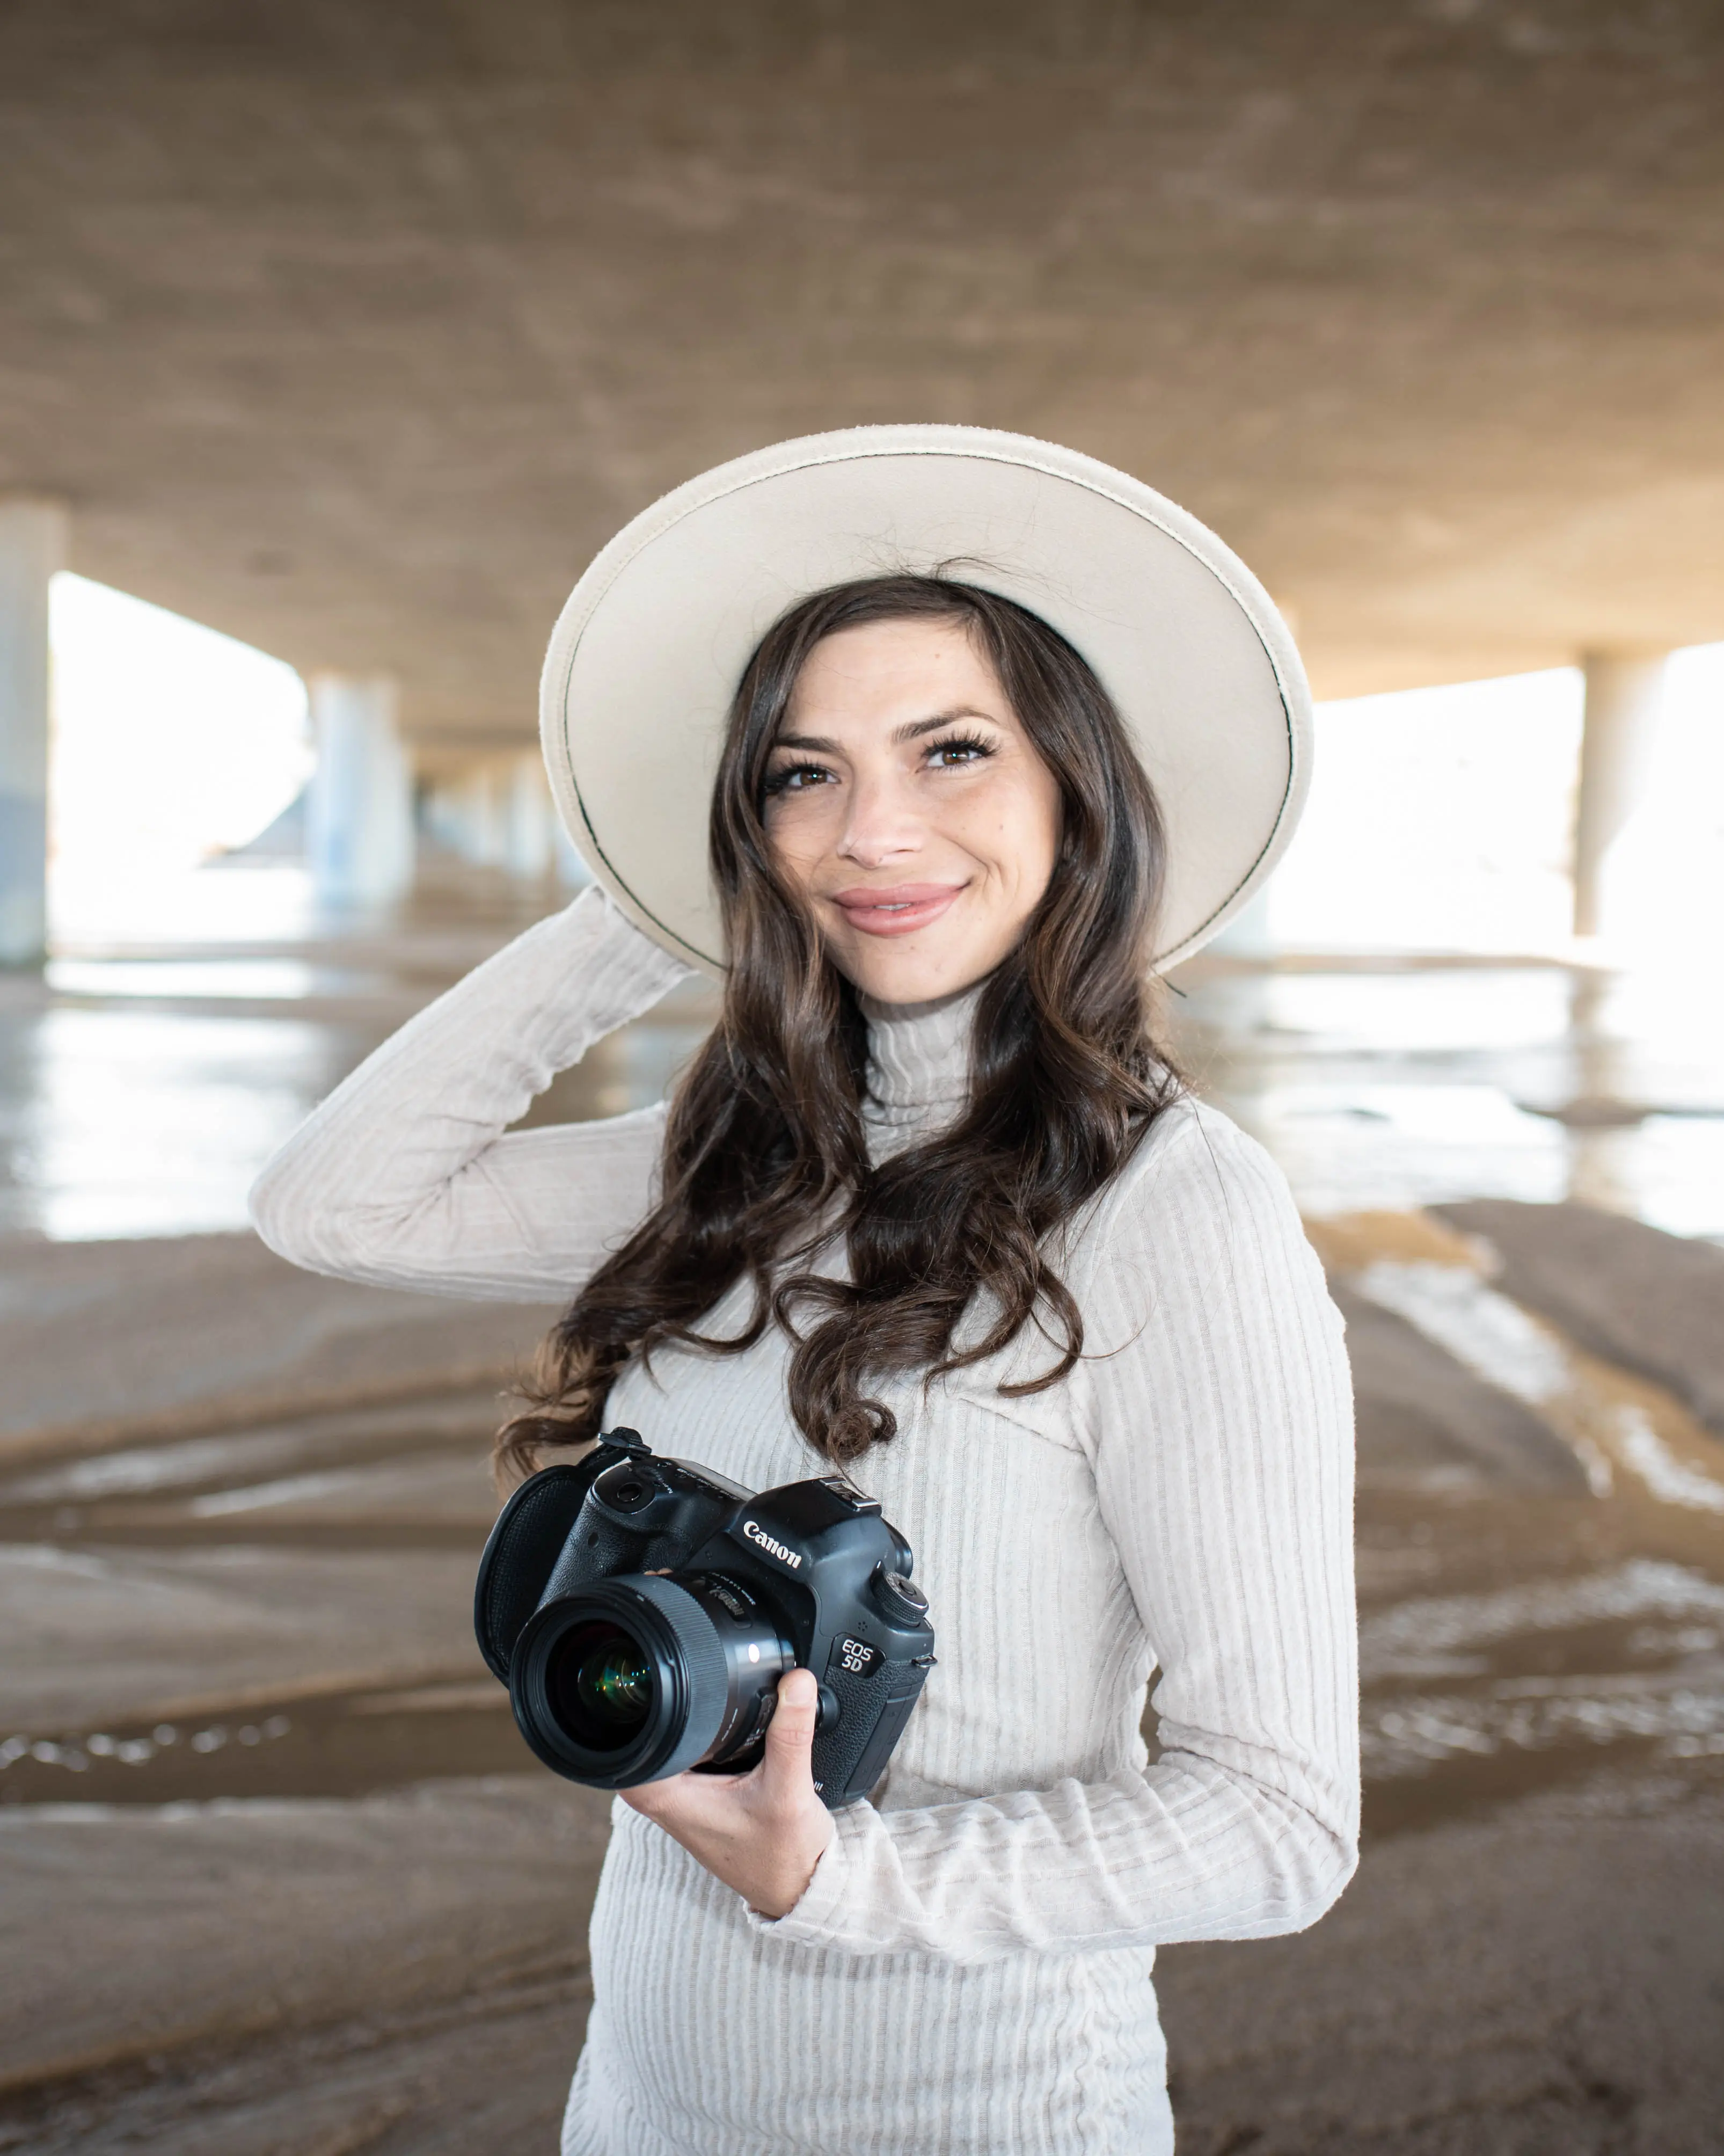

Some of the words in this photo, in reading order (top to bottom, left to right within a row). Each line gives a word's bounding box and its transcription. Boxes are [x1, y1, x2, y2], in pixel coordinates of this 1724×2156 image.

[743, 1520, 802, 1569] Canon
[842, 1639, 873, 1661] EOS
[842, 1654, 863, 1672] 5D
